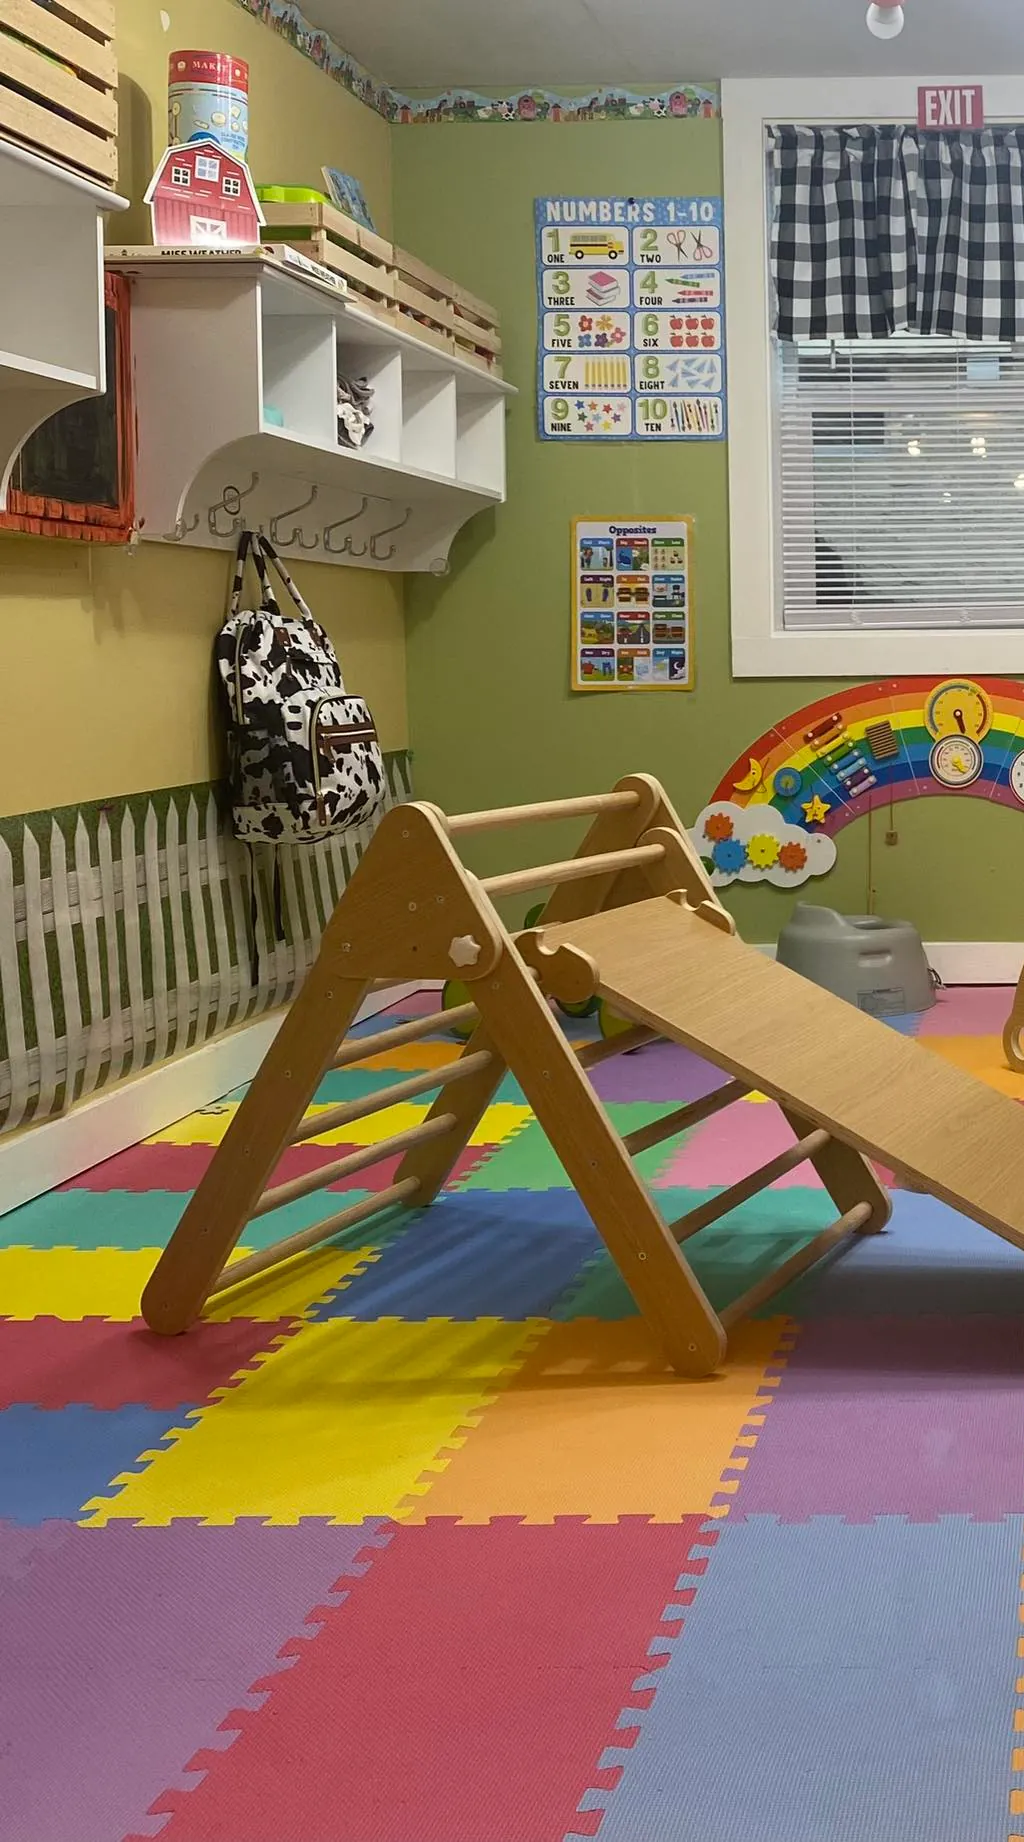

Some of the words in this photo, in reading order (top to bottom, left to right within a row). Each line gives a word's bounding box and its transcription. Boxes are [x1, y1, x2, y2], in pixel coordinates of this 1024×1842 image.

[925, 89, 975, 126] EXIT
[546, 201, 656, 222] NUMBERS
[667, 202, 714, 222] 1-10
[546, 229, 560, 252] 1
[639, 229, 659, 251] 2
[547, 254, 565, 263] ONE
[640, 254, 661, 263] TWO
[552, 271, 571, 294] 3
[639, 271, 659, 294] 4
[547, 297, 575, 306] THREE
[639, 297, 663, 306] FOUR
[553, 313, 571, 336] 5
[642, 313, 660, 336] 6
[551, 338, 572, 348] FIVE
[643, 338, 659, 347] SIX
[553, 356, 572, 379] 7
[642, 355, 660, 379] 8
[549, 380, 579, 390] SEVEN
[639, 381, 665, 390] EIGHT
[551, 398, 569, 421] 9
[638, 398, 668, 420] 10
[551, 423, 572, 432] NINE
[645, 423, 662, 431] TEN
[608, 525, 657, 536] Opposites
